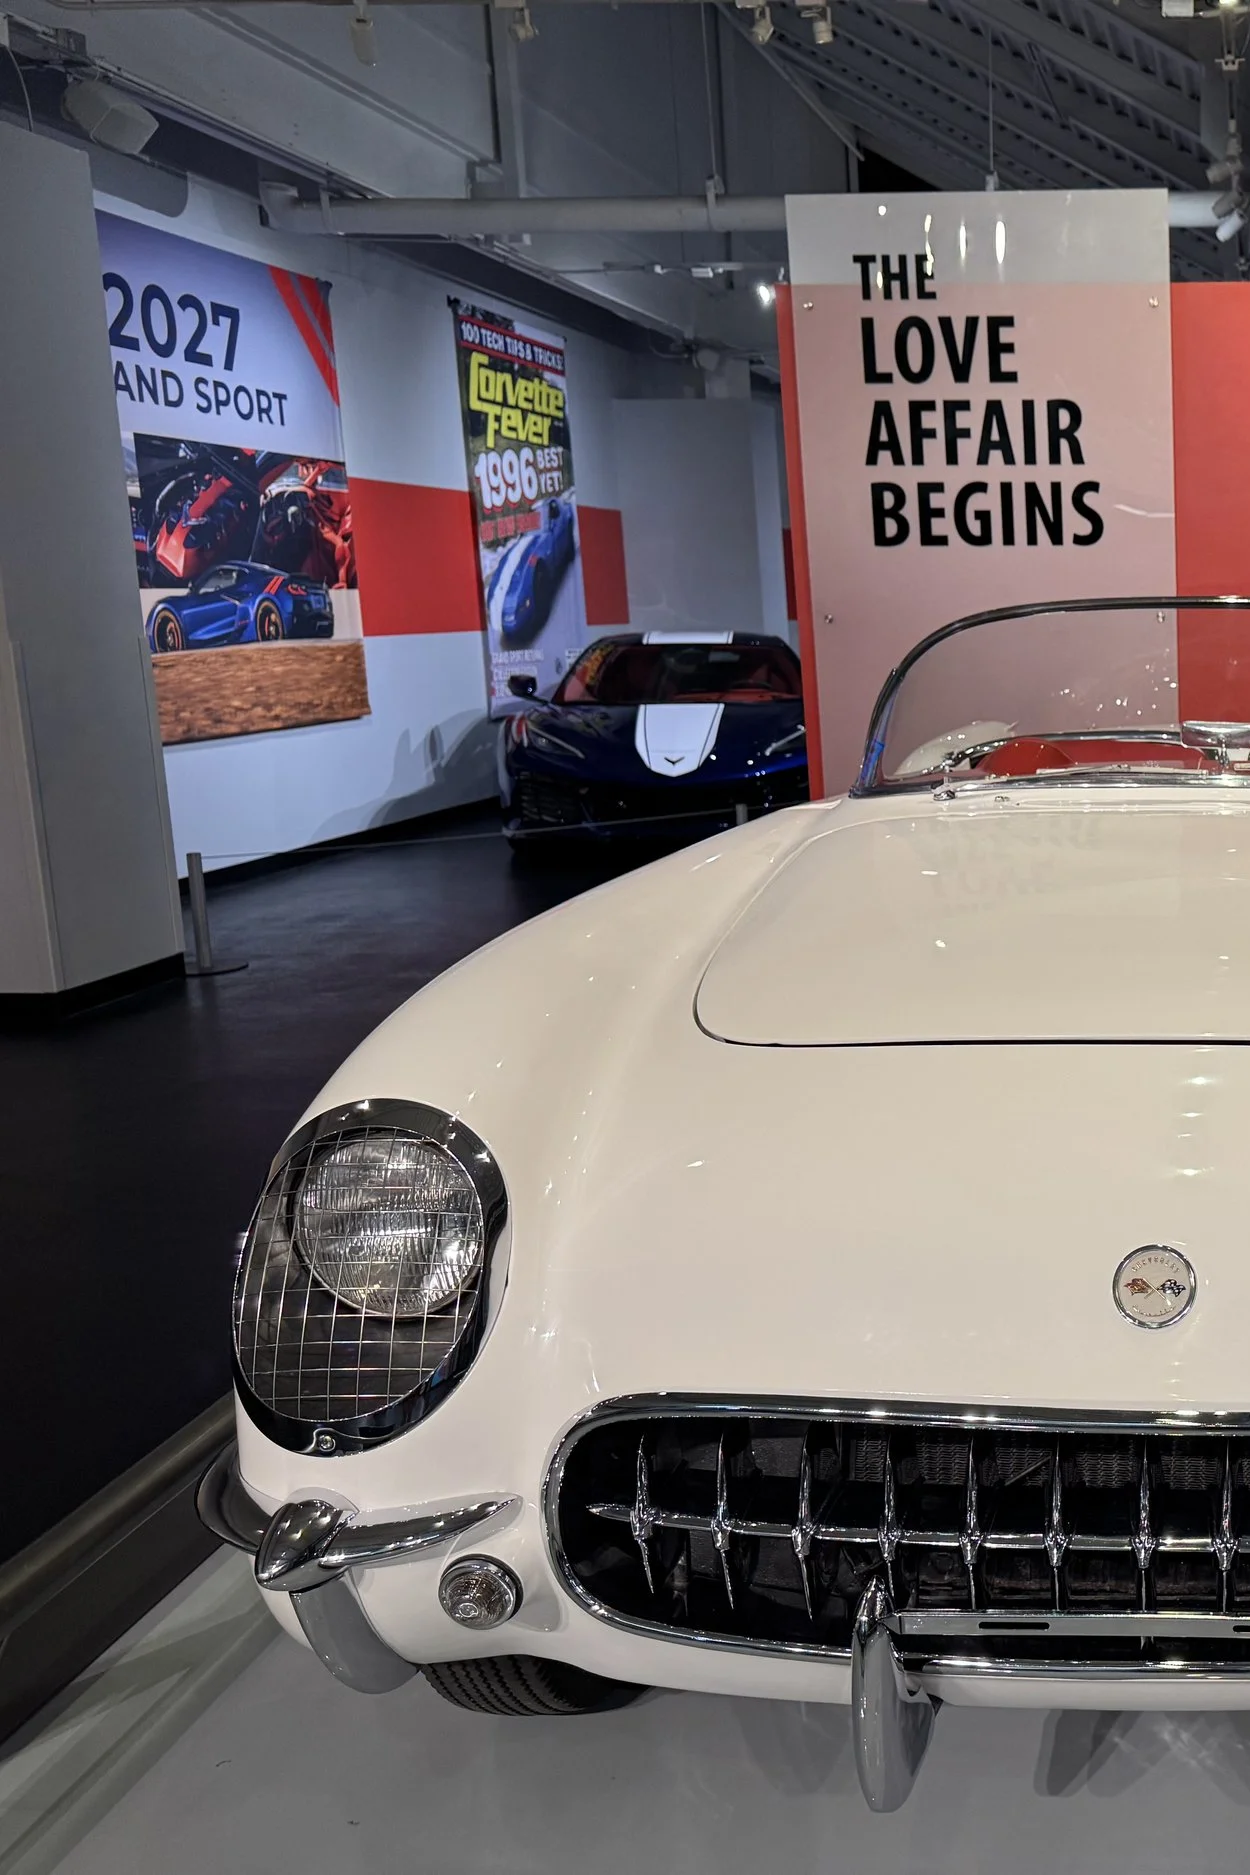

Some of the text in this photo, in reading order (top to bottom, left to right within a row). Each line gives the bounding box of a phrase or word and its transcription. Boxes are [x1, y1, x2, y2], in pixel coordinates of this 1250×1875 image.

[853, 254, 937, 300] THE
[102, 272, 240, 372] 2027
[461, 321, 480, 344] 100
[481, 328, 505, 353] TECH
[861, 315, 1018, 384] LOVE
[114, 360, 288, 427] AND SPORT
[469, 351, 564, 419] Corvette
[484, 402, 552, 449] Fever
[536, 446, 563, 469] BEST
[865, 399, 1085, 466] AFFAIR
[474, 446, 539, 511] 1996
[539, 470, 564, 494] YET!
[871, 481, 1104, 547] BEGINS
